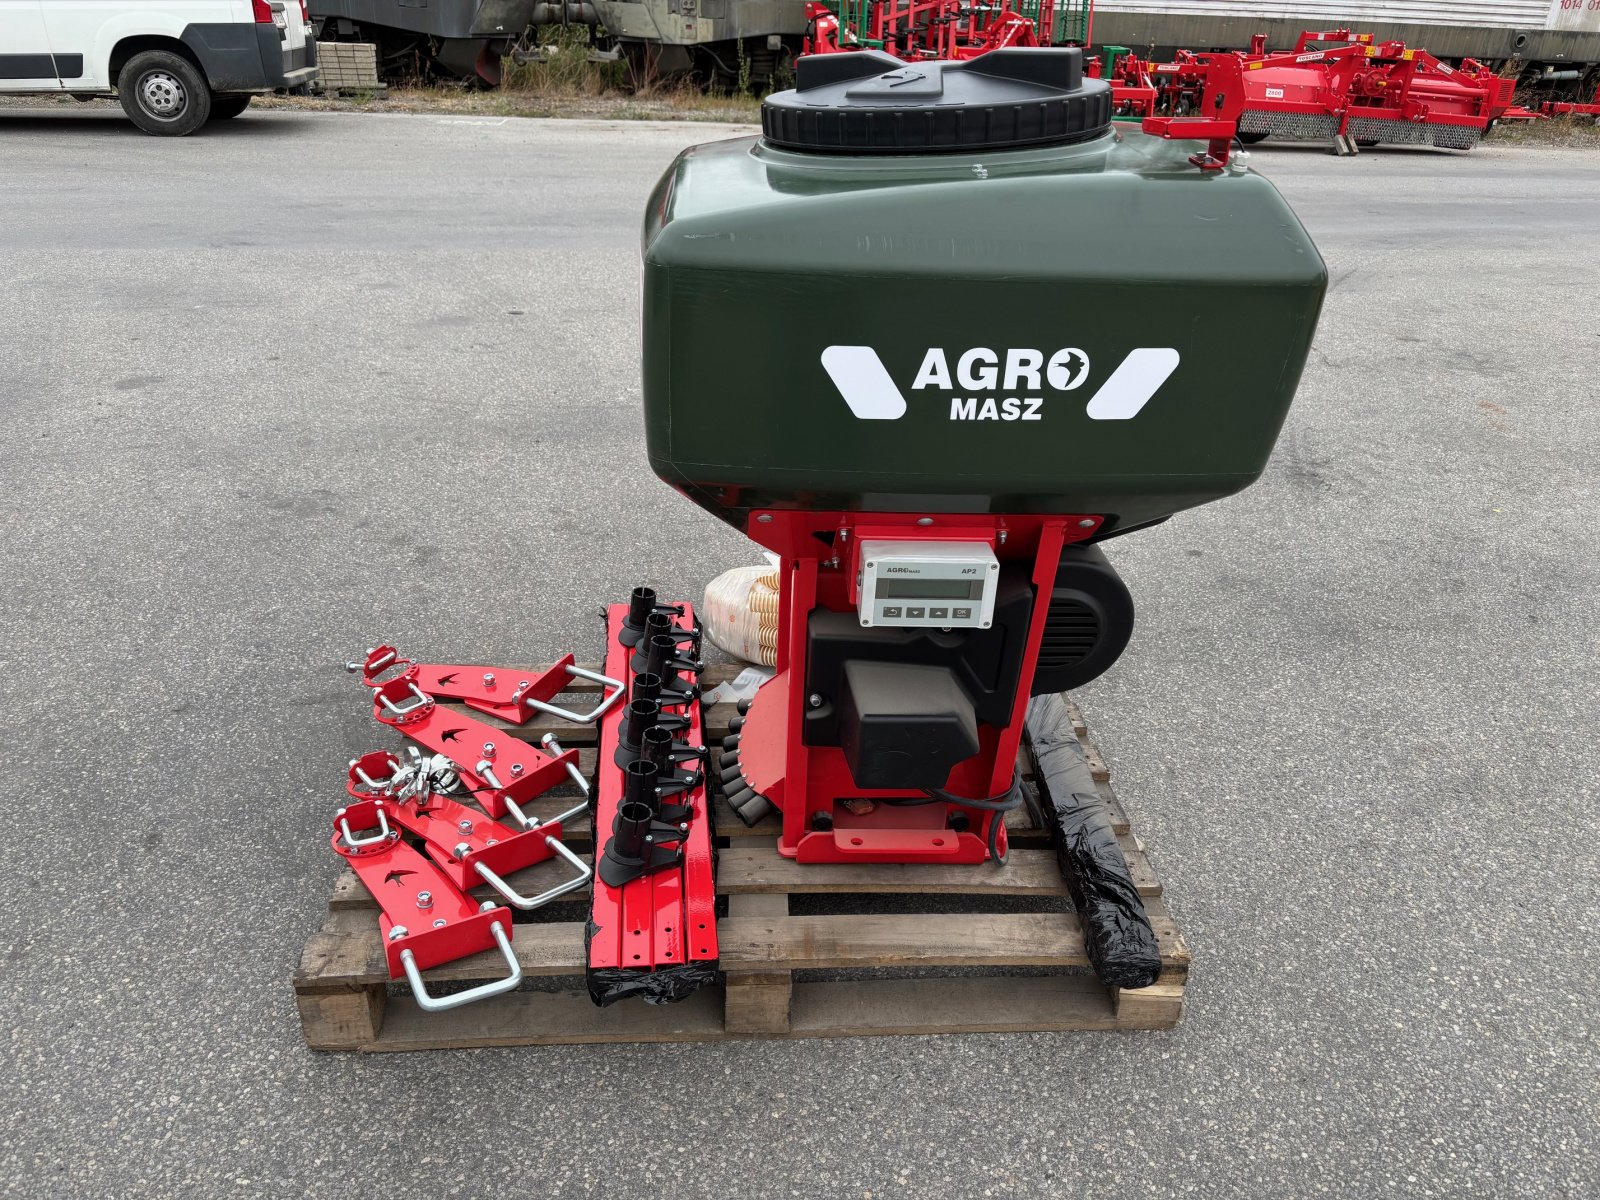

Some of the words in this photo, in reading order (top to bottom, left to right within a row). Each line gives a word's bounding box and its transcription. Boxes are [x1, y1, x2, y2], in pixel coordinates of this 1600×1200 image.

[1560, 0, 1583, 10] 1014
[1587, 0, 1600, 11] 01
[911, 347, 1090, 391] AGRO
[950, 398, 1044, 421] MASZ
